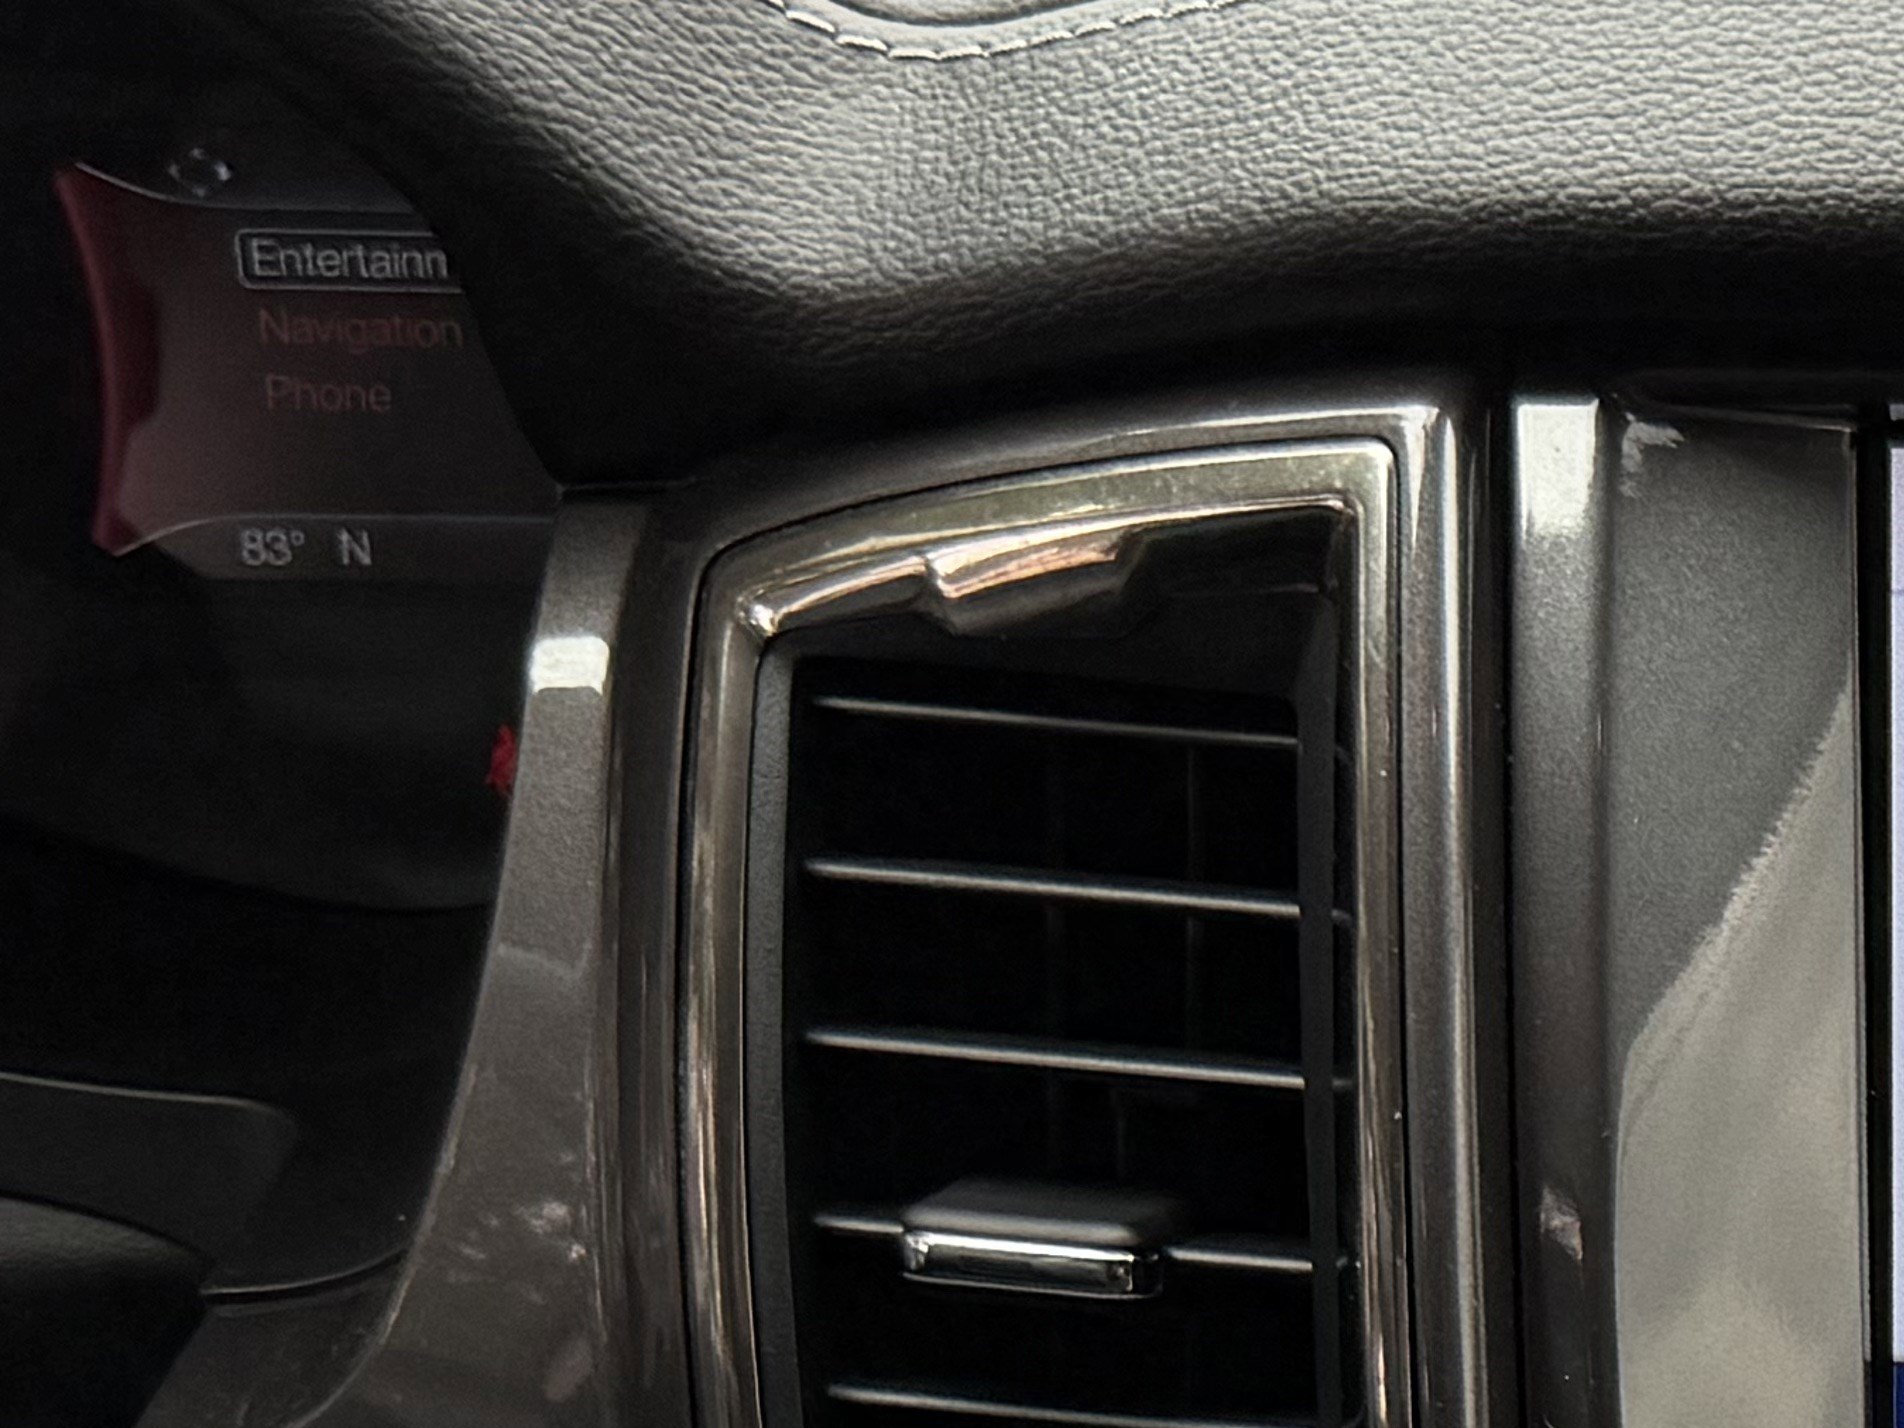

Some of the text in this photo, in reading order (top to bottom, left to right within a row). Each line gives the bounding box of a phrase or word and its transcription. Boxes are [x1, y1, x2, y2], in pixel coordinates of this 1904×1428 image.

[258, 308, 465, 354] Navigation
[264, 373, 393, 413] Phone
[240, 528, 373, 568] 83° N
